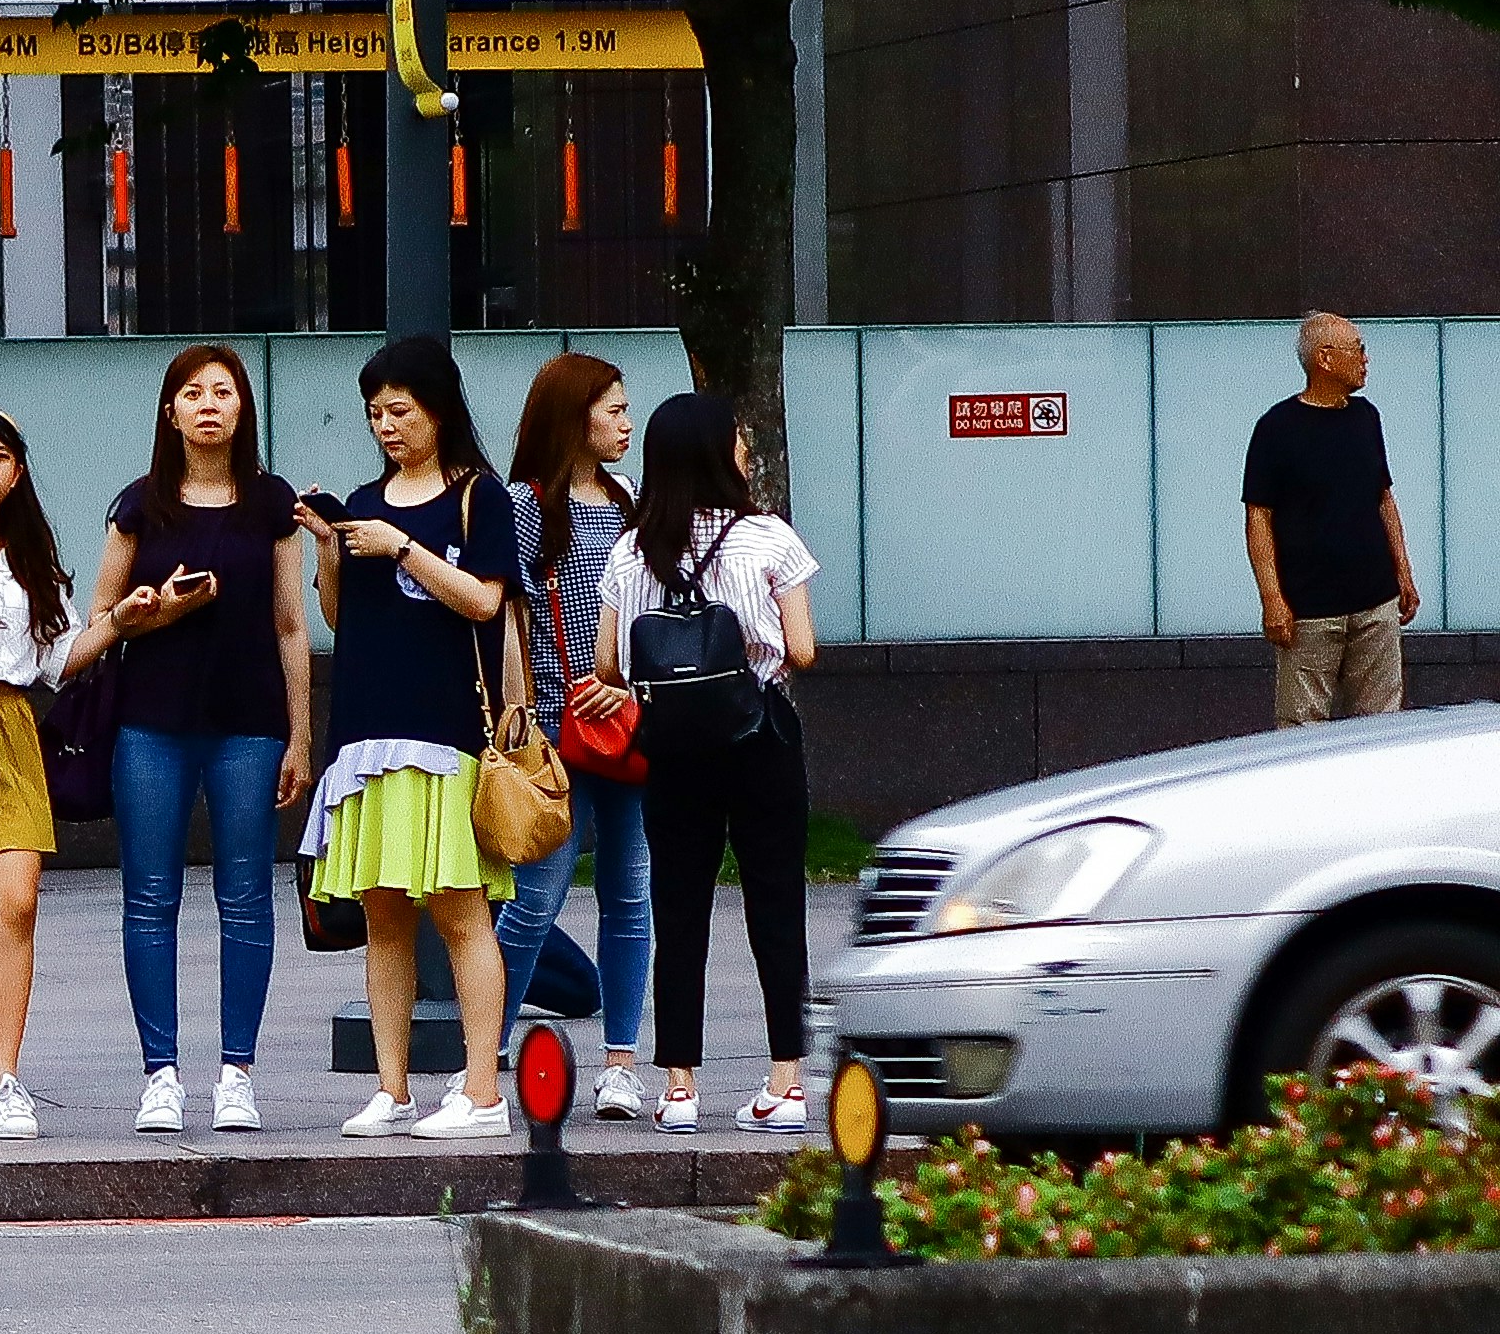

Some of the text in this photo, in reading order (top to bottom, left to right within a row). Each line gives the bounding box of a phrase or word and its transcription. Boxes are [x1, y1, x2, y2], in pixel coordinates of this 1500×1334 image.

[307, 31, 386, 58] Heigh
[555, 29, 618, 53] 1.9M
[955, 418, 1024, 430] DO NOT CLIMB
